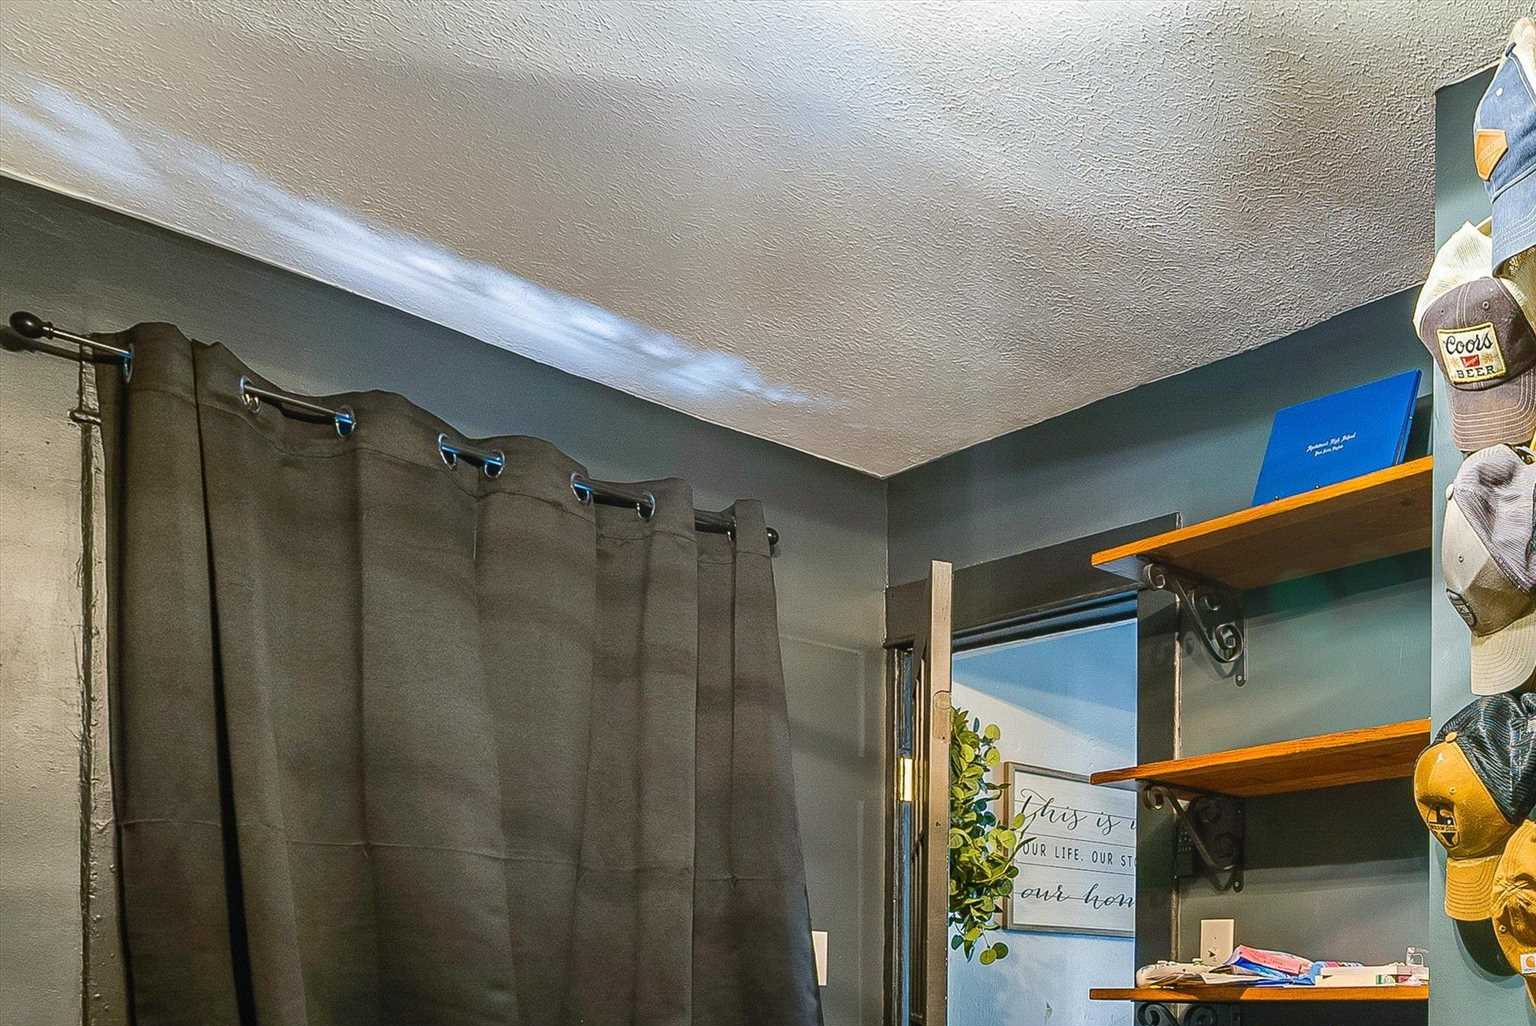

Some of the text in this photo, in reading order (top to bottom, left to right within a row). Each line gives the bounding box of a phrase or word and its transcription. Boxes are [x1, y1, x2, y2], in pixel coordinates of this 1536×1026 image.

[1446, 333, 1493, 355] Coors
[1456, 365, 1496, 379] BEER
[1021, 788, 1121, 836] This is
[1022, 844, 1048, 857] OUR
[1092, 851, 1113, 865] OUR
[1021, 884, 1067, 905] our
